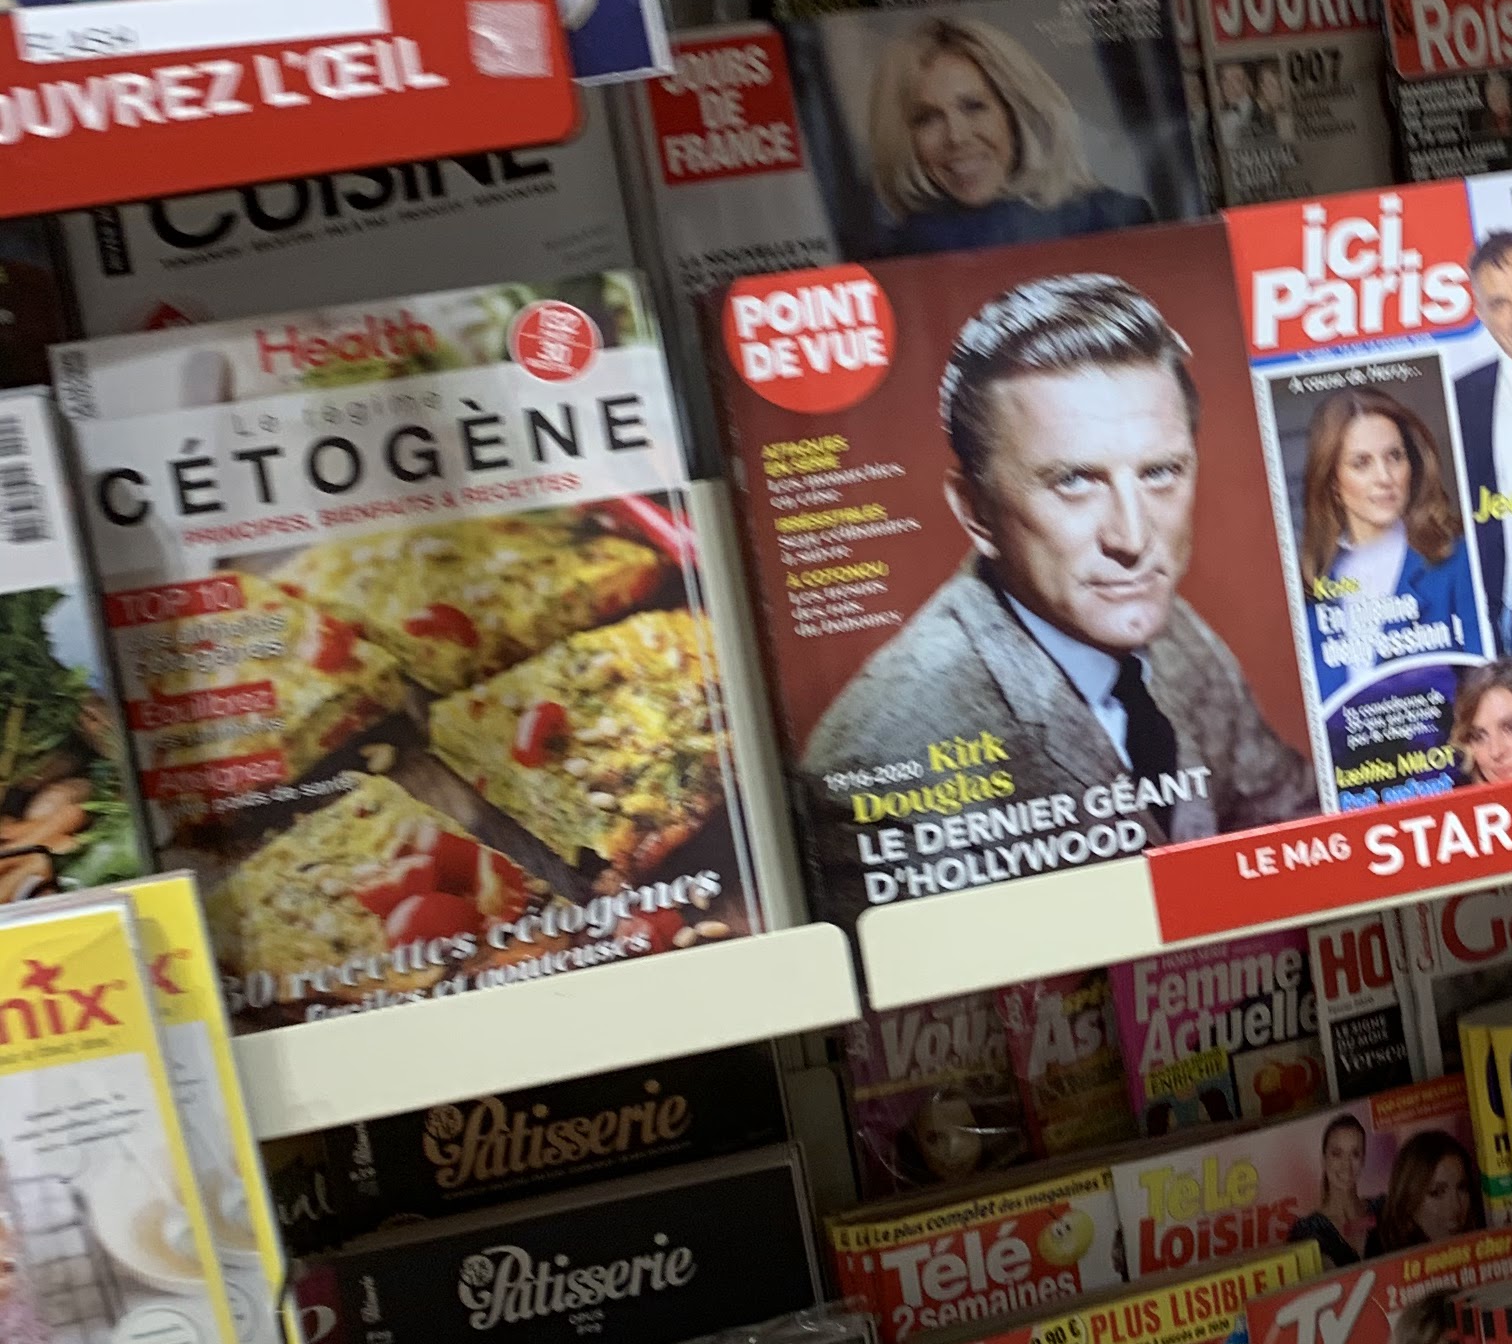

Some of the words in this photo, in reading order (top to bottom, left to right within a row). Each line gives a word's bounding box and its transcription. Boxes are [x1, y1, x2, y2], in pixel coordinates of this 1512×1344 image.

[666, 121, 798, 175] FRANCE
[1303, 191, 1403, 282] ici
[734, 278, 877, 339] POINT
[1251, 256, 1474, 350] Paris
[256, 313, 438, 375] Health
[101, 393, 653, 527] CÉTOGÈNE
[928, 730, 1010, 777] Kirk
[851, 767, 1017, 824] Douglas
[916, 796, 1080, 856] DERNIER
[1083, 764, 1213, 820] GÉANT
[865, 819, 1150, 905] D'HOLLYWOOD
[1236, 846, 1279, 880] LE
[1281, 832, 1352, 870] MAG
[1134, 947, 1303, 1025] Femme
[879, 1218, 1033, 1310] Télé
[918, 1272, 1080, 1329] semaines
[1172, 1268, 1270, 1332] LISIBLE
